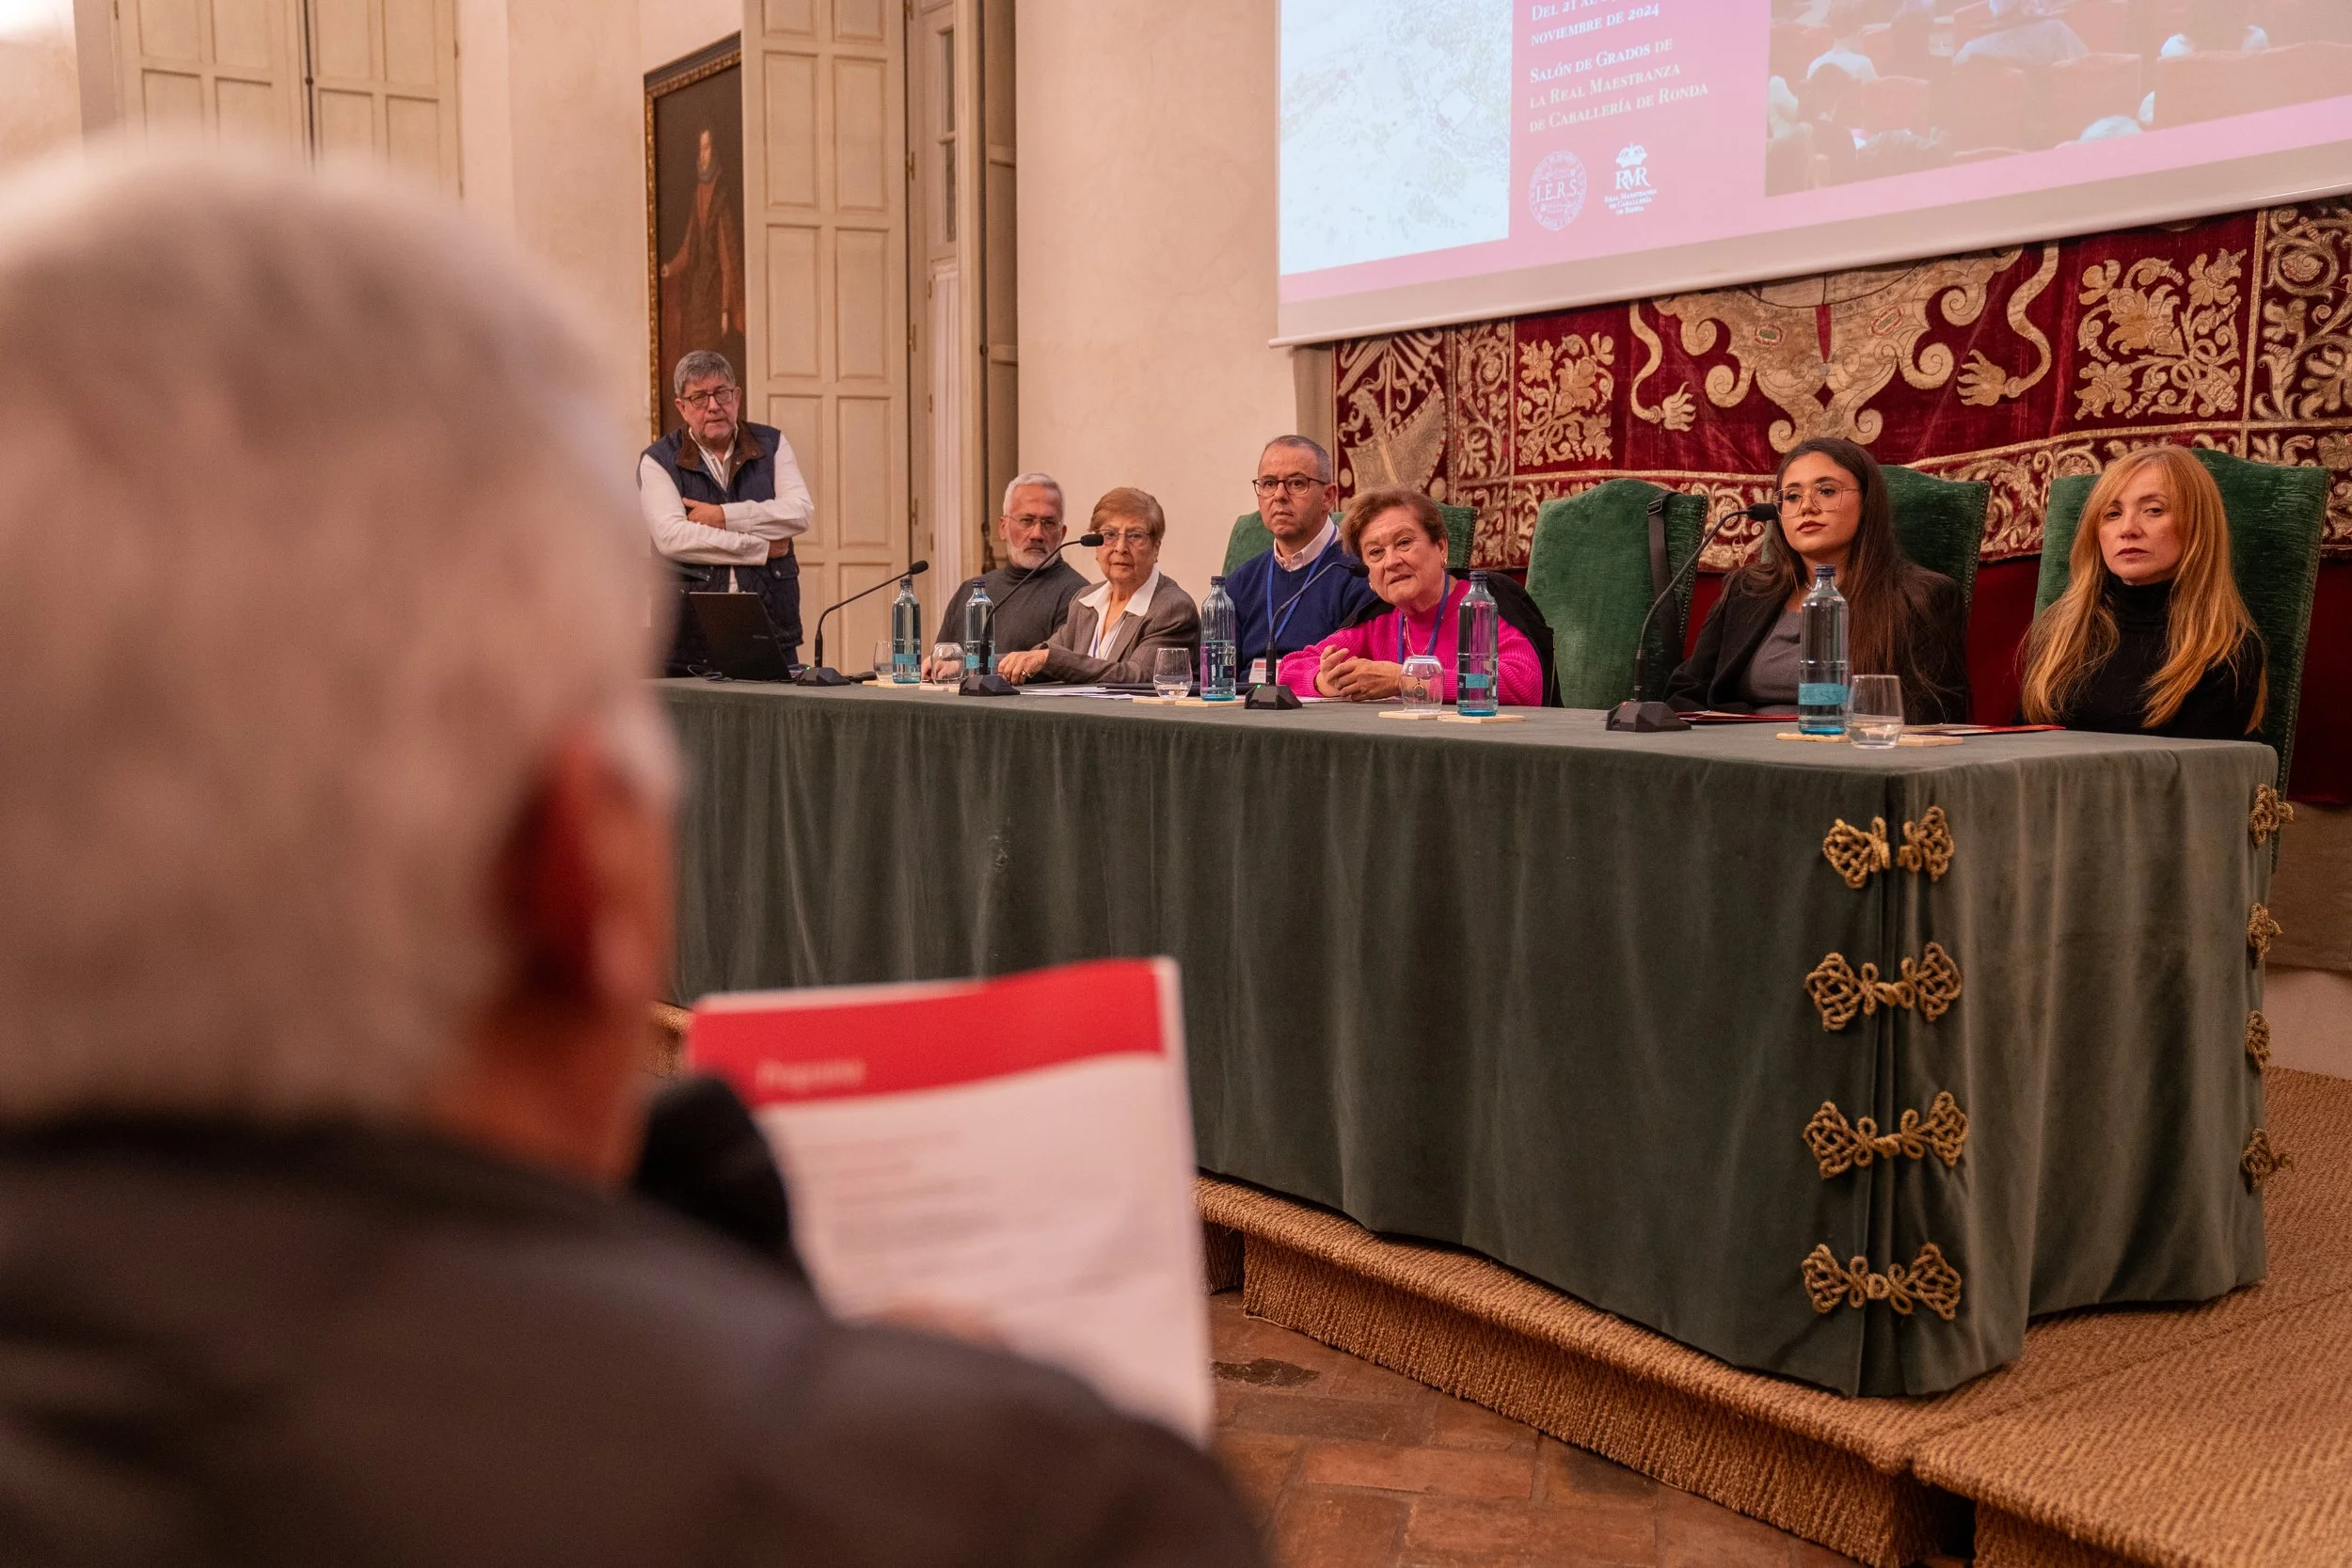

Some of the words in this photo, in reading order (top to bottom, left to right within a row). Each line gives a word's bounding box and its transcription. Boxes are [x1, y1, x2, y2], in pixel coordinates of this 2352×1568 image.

[1531, 4, 1559, 21] DEL
[1562, 0, 1577, 12] 21
[1531, 17, 1603, 46] NOVIEMBRE
[1606, 11, 1624, 26] DE
[1628, 3, 1660, 21] 2024
[1530, 61, 1572, 83] SALÓN
[1575, 58, 1593, 72] DE
[1596, 43, 1651, 68] GRADOS
[1655, 38, 1674, 54] DE
[1529, 119, 1546, 133] DE
[1549, 98, 1631, 128] CABALLERÍA
[1637, 94, 1655, 109] DE
[1659, 84, 1708, 104] RONDA
[1530, 95, 1546, 109] LA
[1549, 86, 1586, 104] REAL
[1590, 64, 1681, 95] MAESTRANZA
